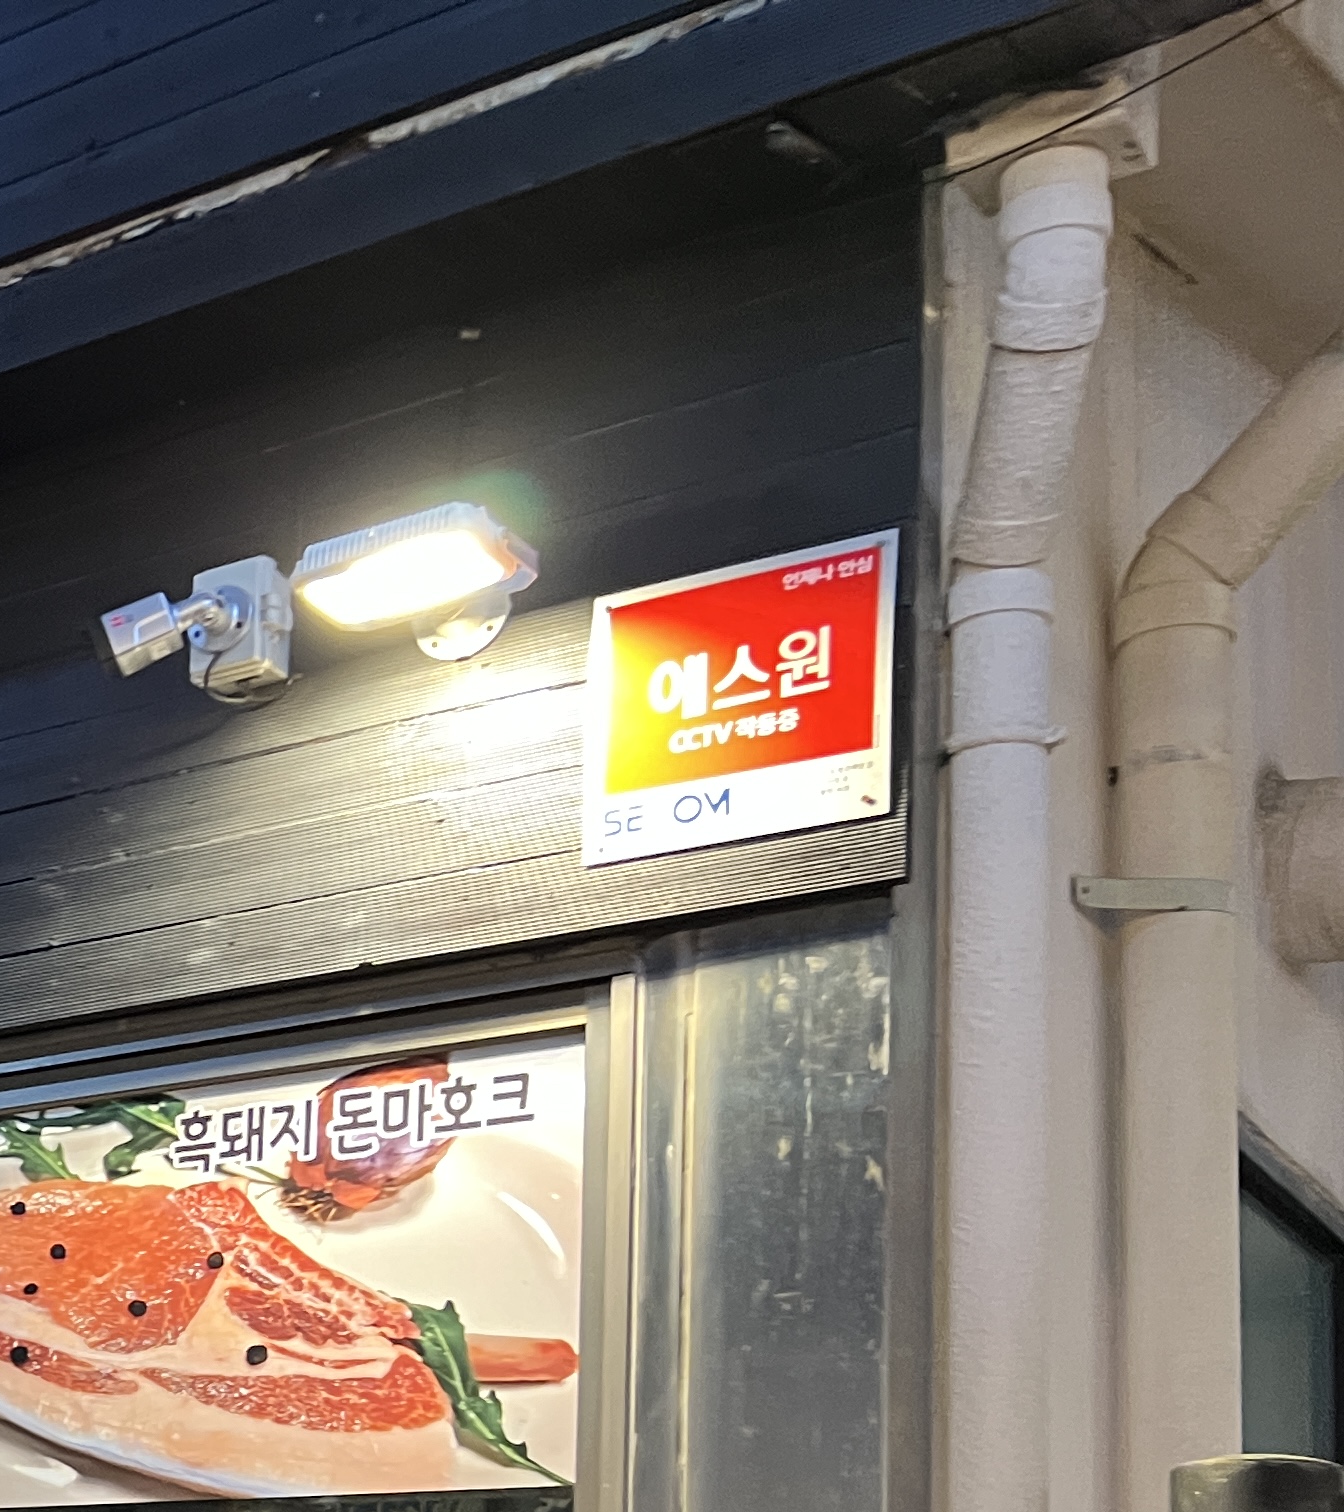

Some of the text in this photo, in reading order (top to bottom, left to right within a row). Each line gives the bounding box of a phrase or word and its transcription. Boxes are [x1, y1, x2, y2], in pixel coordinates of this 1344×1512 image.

[648, 624, 832, 720] 에스원
[668, 721, 734, 754] CCTV
[604, 788, 731, 837] SEOM
[173, 1072, 536, 1173] 흑돼지 돈마호크
